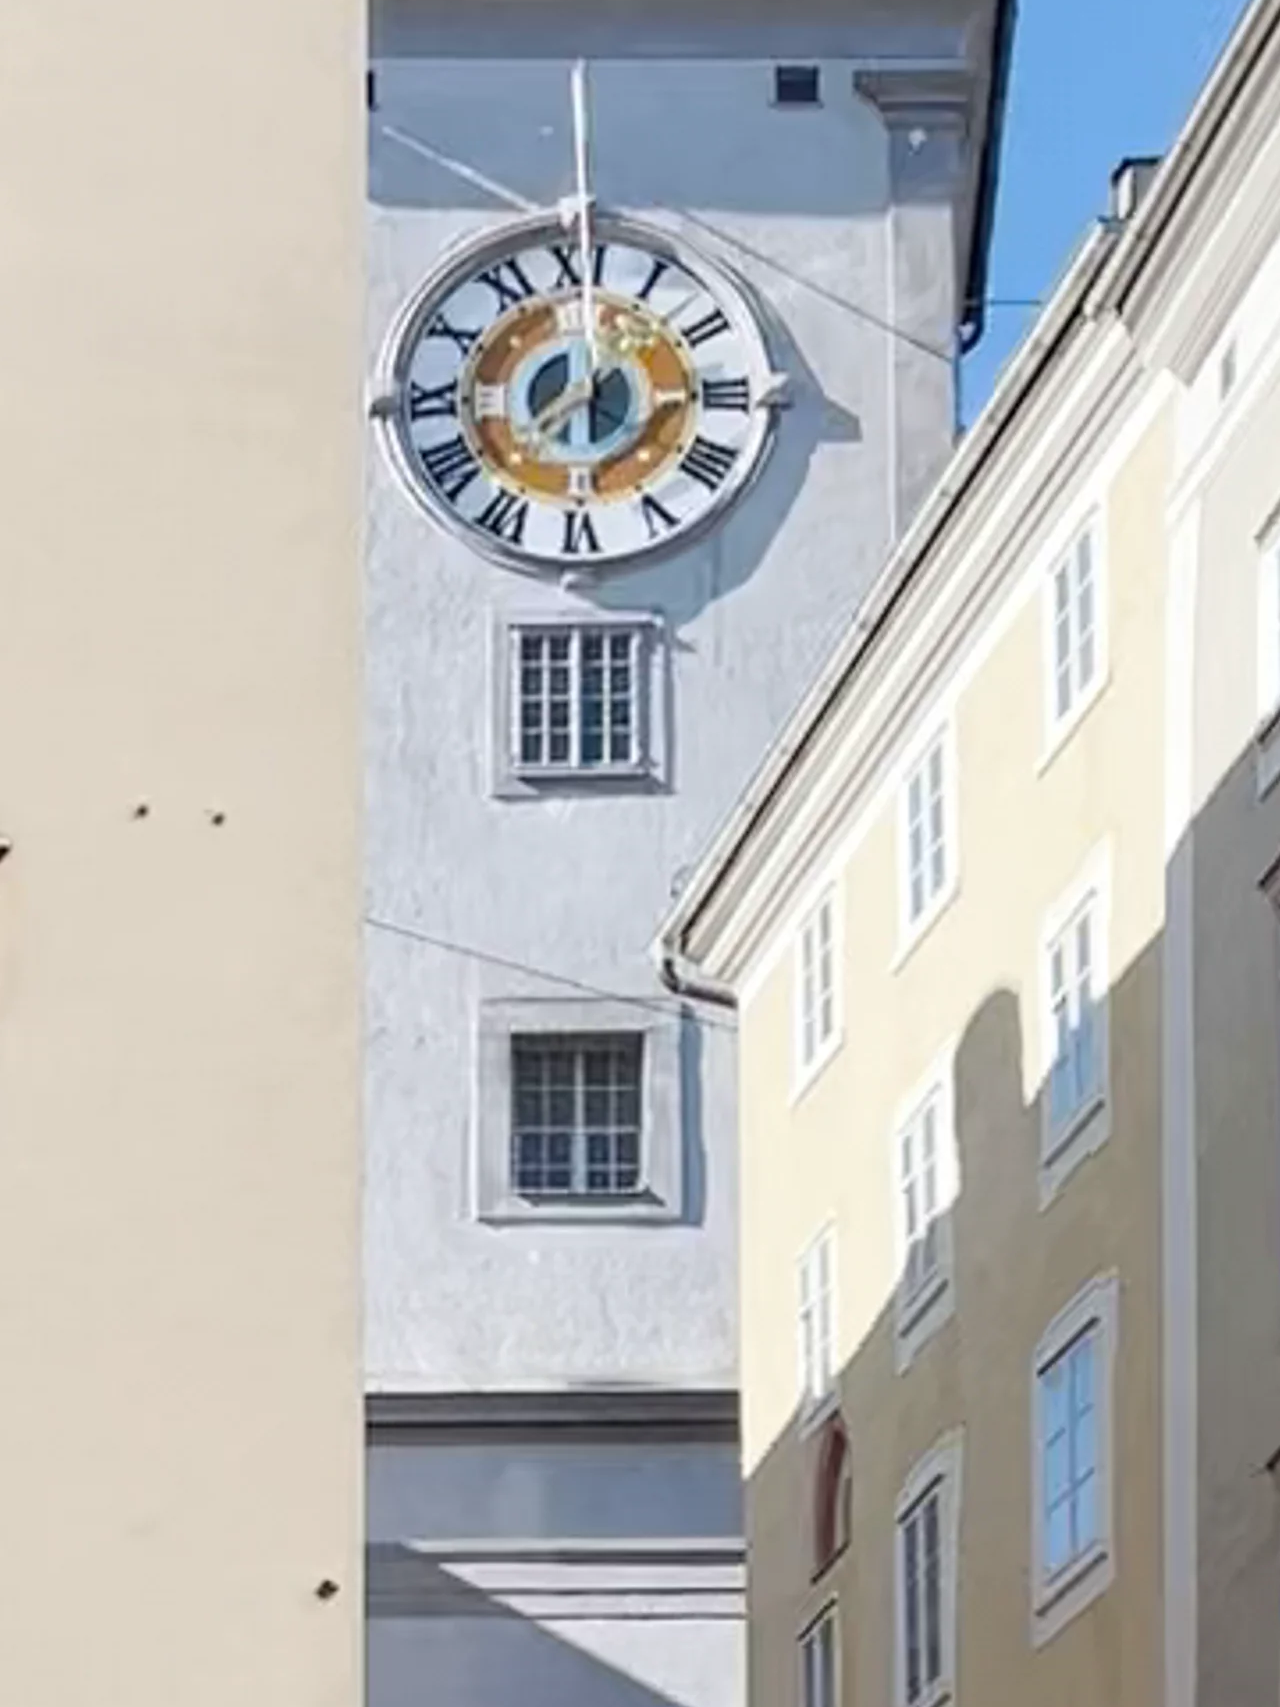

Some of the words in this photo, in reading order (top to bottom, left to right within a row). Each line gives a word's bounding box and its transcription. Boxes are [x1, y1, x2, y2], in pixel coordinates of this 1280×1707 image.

[547, 244, 606, 289] XI
[426, 319, 477, 355] X
[680, 308, 730, 346] II
[409, 380, 458, 420] IX
[701, 377, 750, 412] III
[559, 509, 604, 554] VI
[640, 494, 681, 539] V
